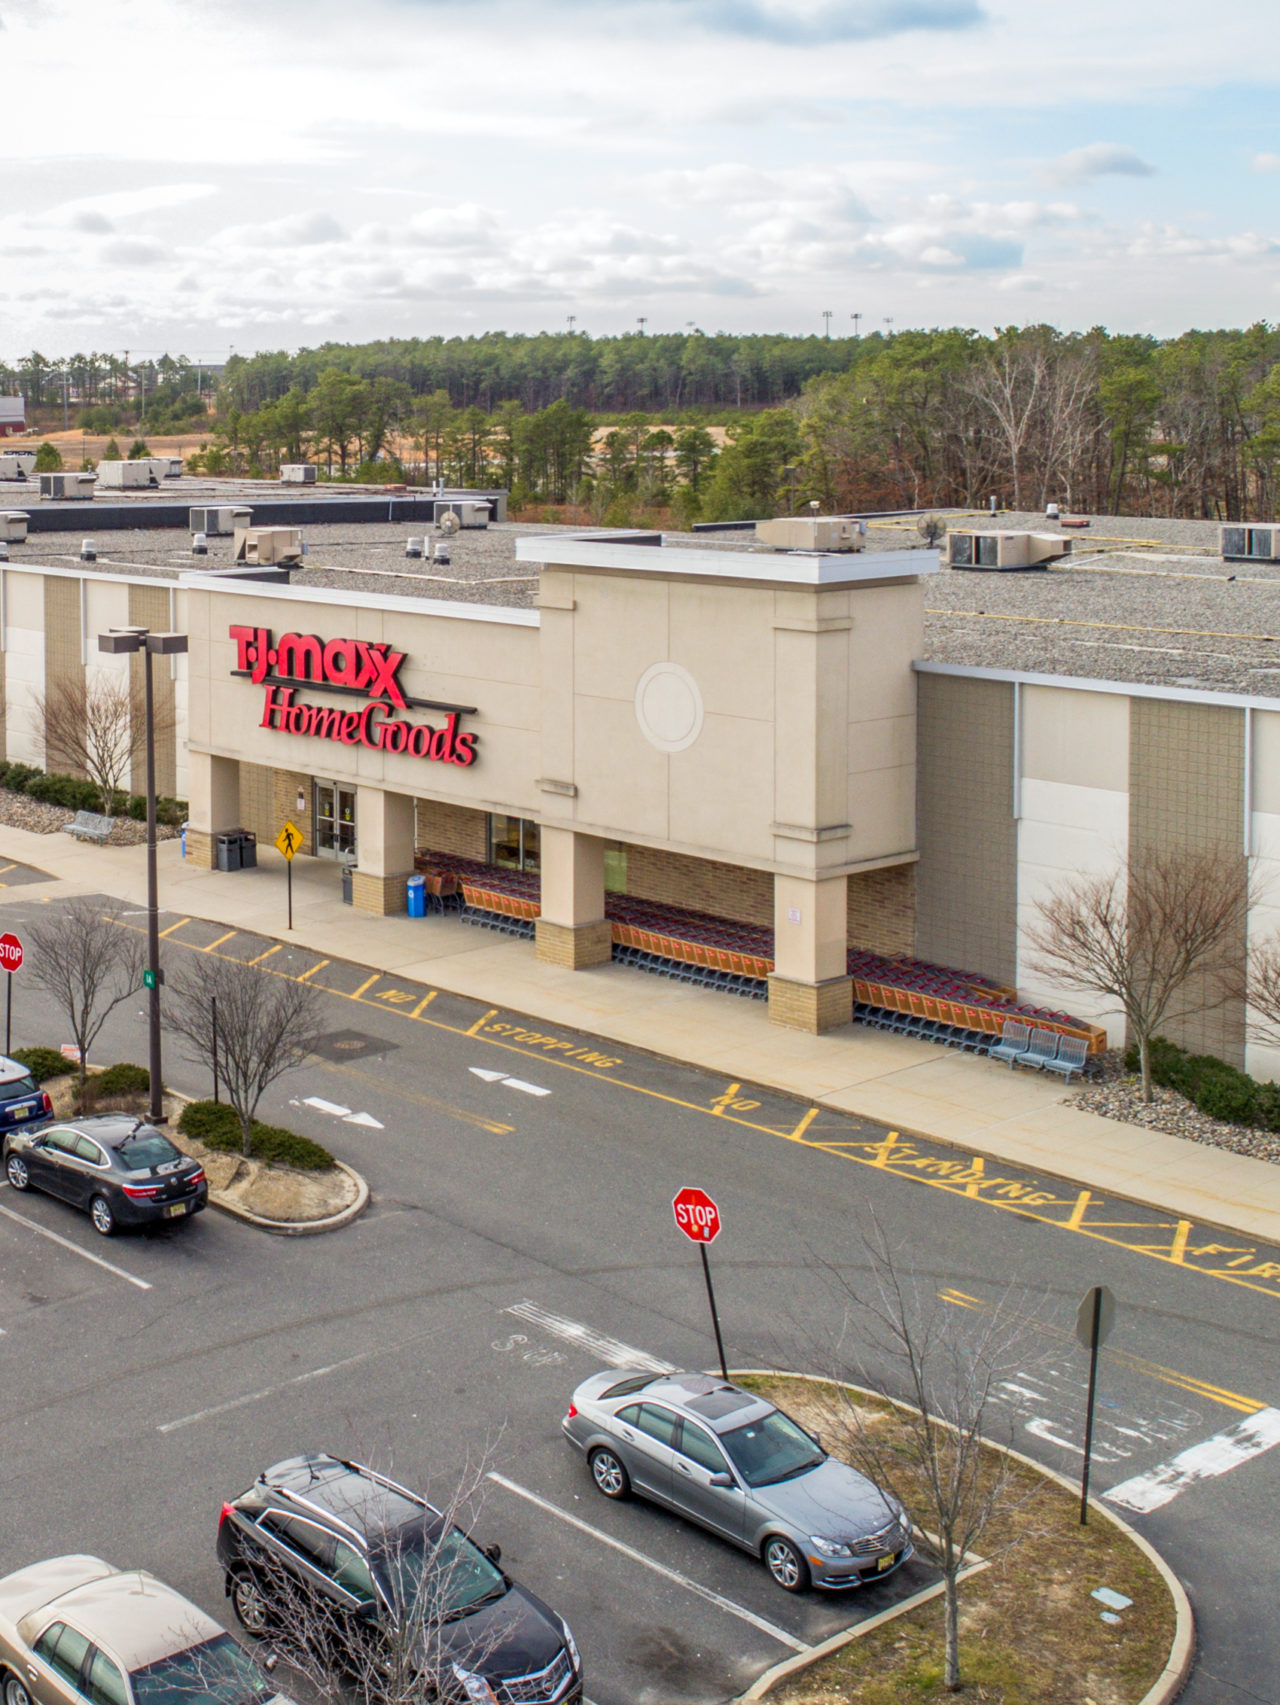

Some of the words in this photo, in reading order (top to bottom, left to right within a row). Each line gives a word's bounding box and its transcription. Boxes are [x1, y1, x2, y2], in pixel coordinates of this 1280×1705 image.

[259, 684, 480, 767] HomeGoods
[376, 989, 417, 1003] NO
[484, 1022, 623, 1069] STOPPING
[1191, 1243, 1280, 1284] FIR
[677, 1203, 716, 1227] STOP
